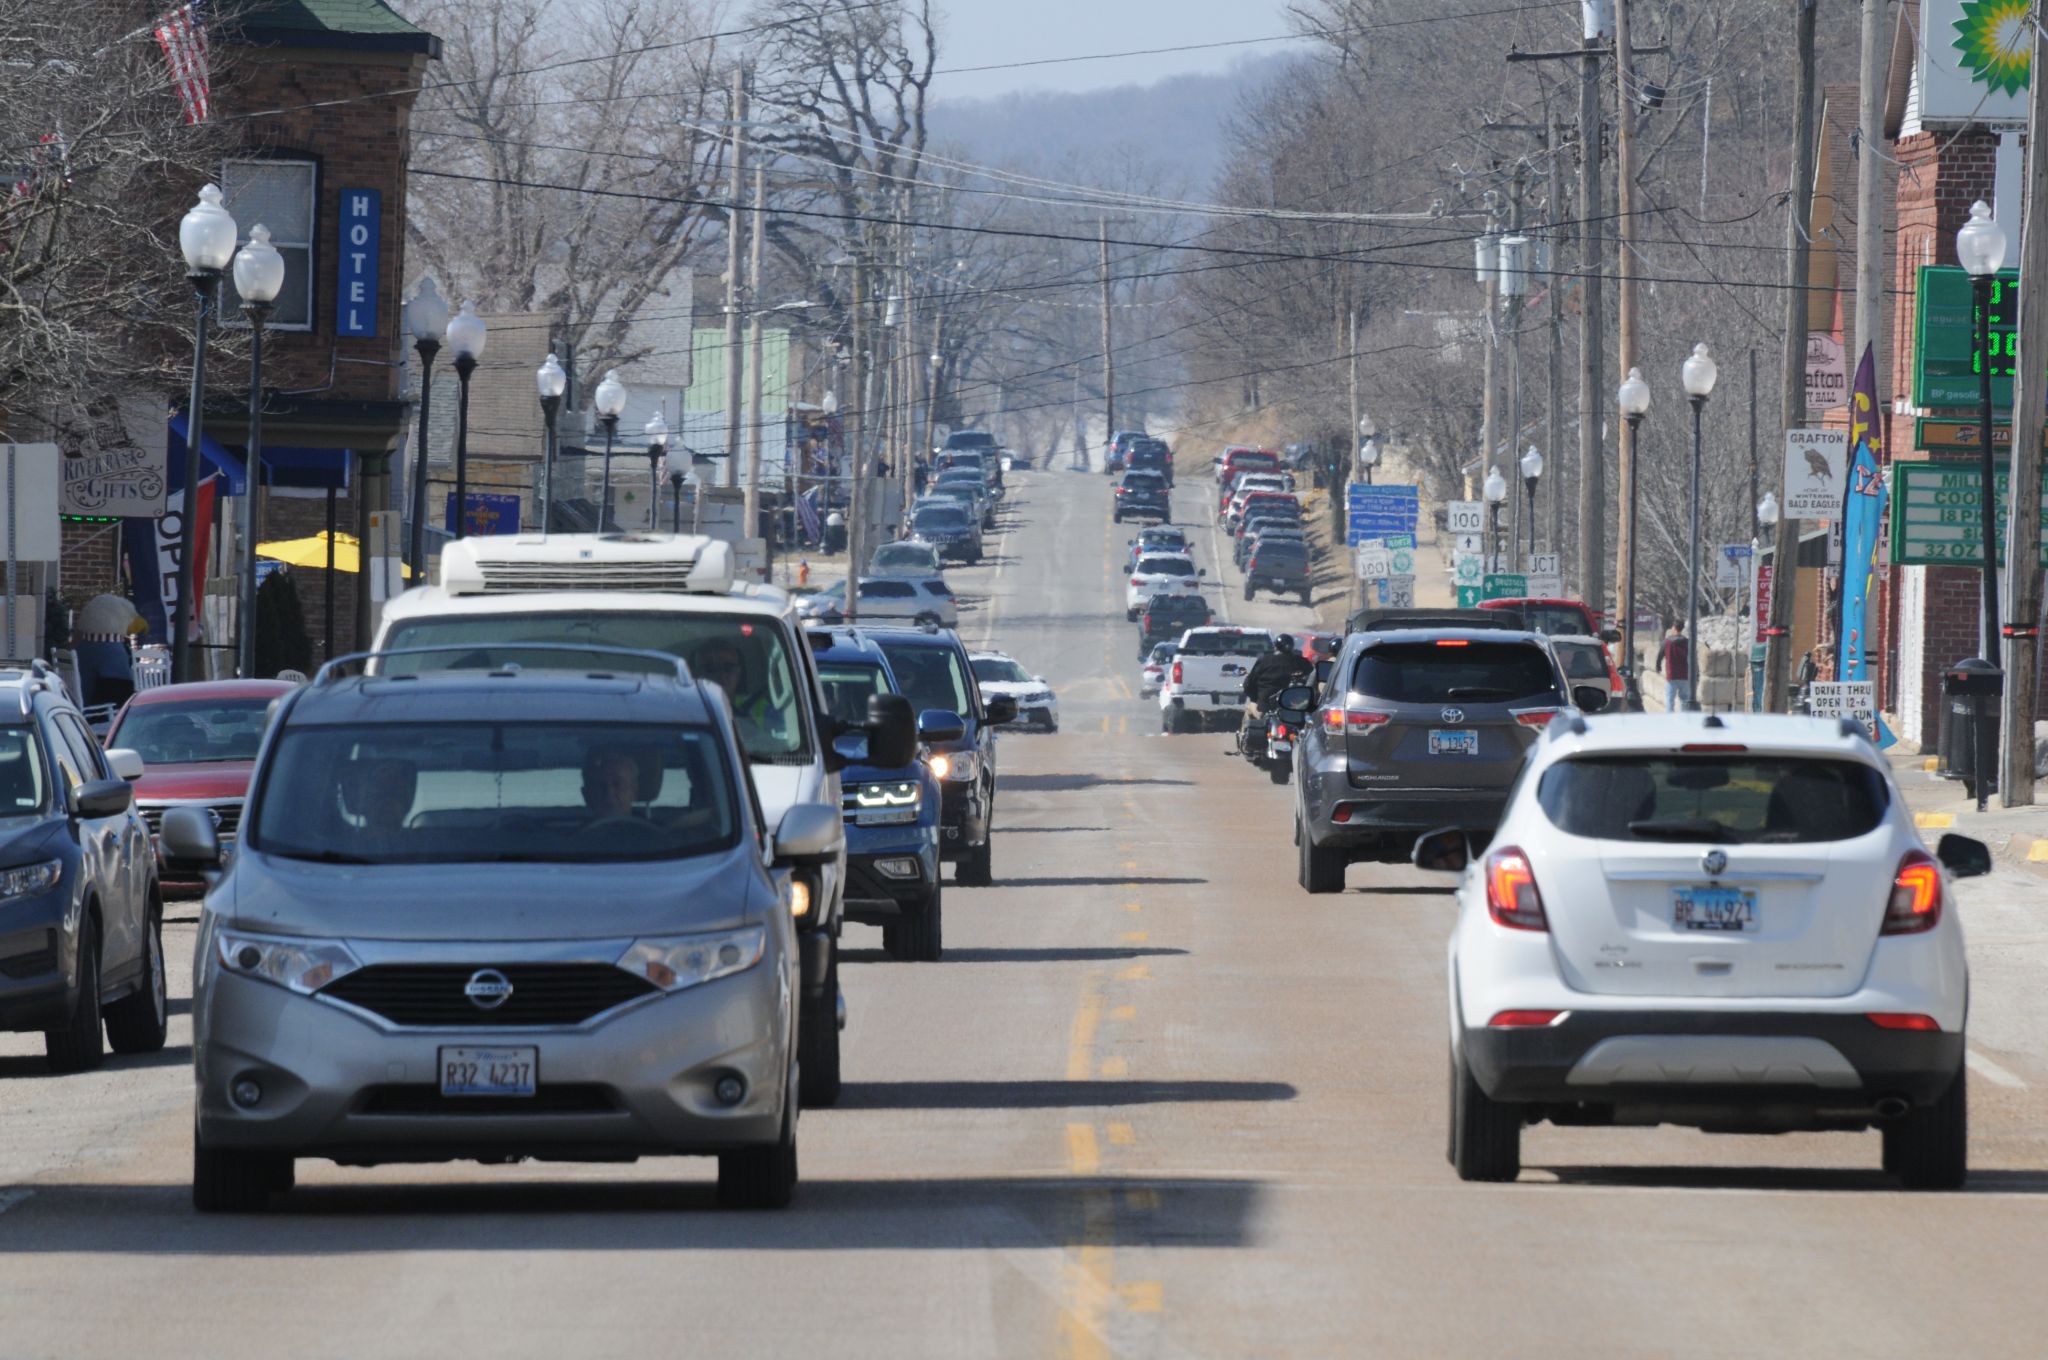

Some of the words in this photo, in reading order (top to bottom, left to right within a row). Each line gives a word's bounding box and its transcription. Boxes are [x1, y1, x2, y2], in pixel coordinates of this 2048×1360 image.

[349, 196, 369, 331] HOTEL
[1815, 391, 1837, 403] HALL
[1931, 389, 1945, 399] BP
[1946, 390, 1981, 401] gasoli
[1789, 433, 1845, 444] GRAFTON
[87, 479, 138, 499] GIFTS
[1788, 500, 1808, 508] BALD
[1811, 500, 1841, 509] EAGLES
[1453, 513, 1480, 528] 100
[1925, 544, 1946, 557] 32
[1950, 544, 1977, 558] OZ
[1362, 562, 1384, 576] 100
[1531, 557, 1555, 573] JCT
[1814, 685, 1841, 695] DRIVE
[1847, 685, 1871, 695] THRU
[1816, 698, 1840, 707] OPEN
[1846, 697, 1866, 708] 12-6
[446, 1062, 478, 1086] R32
[488, 1062, 530, 1086] 4237
